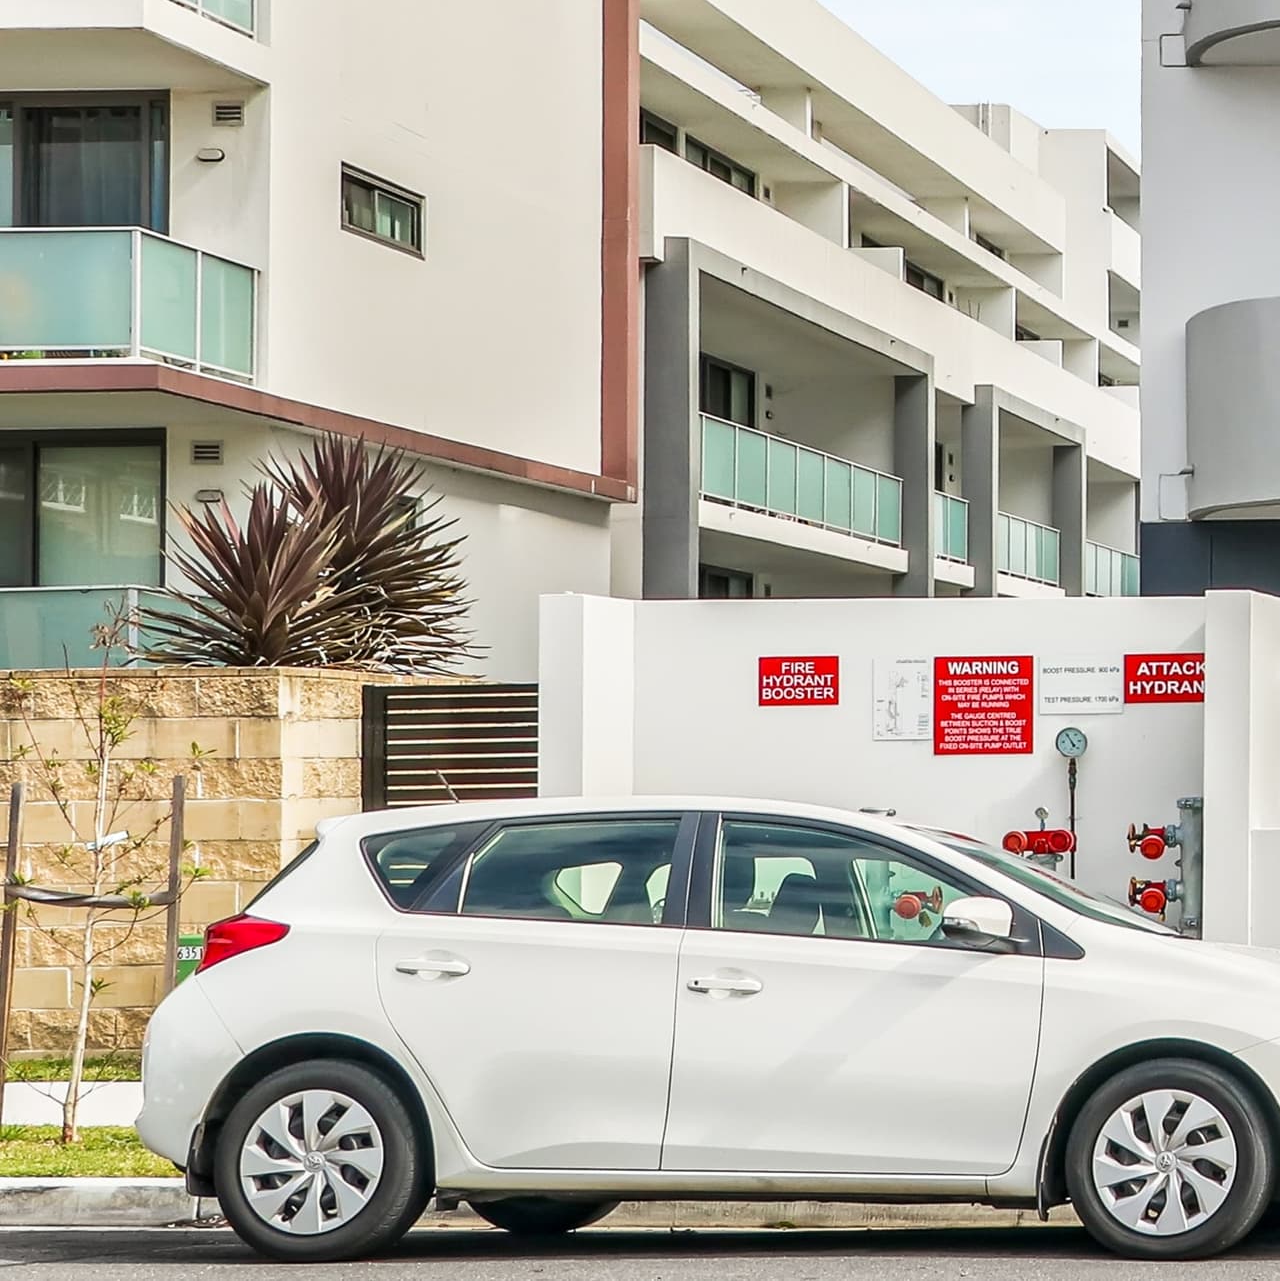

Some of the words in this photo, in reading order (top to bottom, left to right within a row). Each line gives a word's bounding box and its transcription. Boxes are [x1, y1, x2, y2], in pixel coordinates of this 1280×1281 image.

[781, 662, 815, 674] FIRE
[947, 661, 1019, 675] WARNING
[1136, 661, 1205, 676] ATTACK
[762, 674, 834, 687] HYDRANT
[762, 687, 834, 700] BOOSTER
[1129, 680, 1205, 695] HYDRAN
